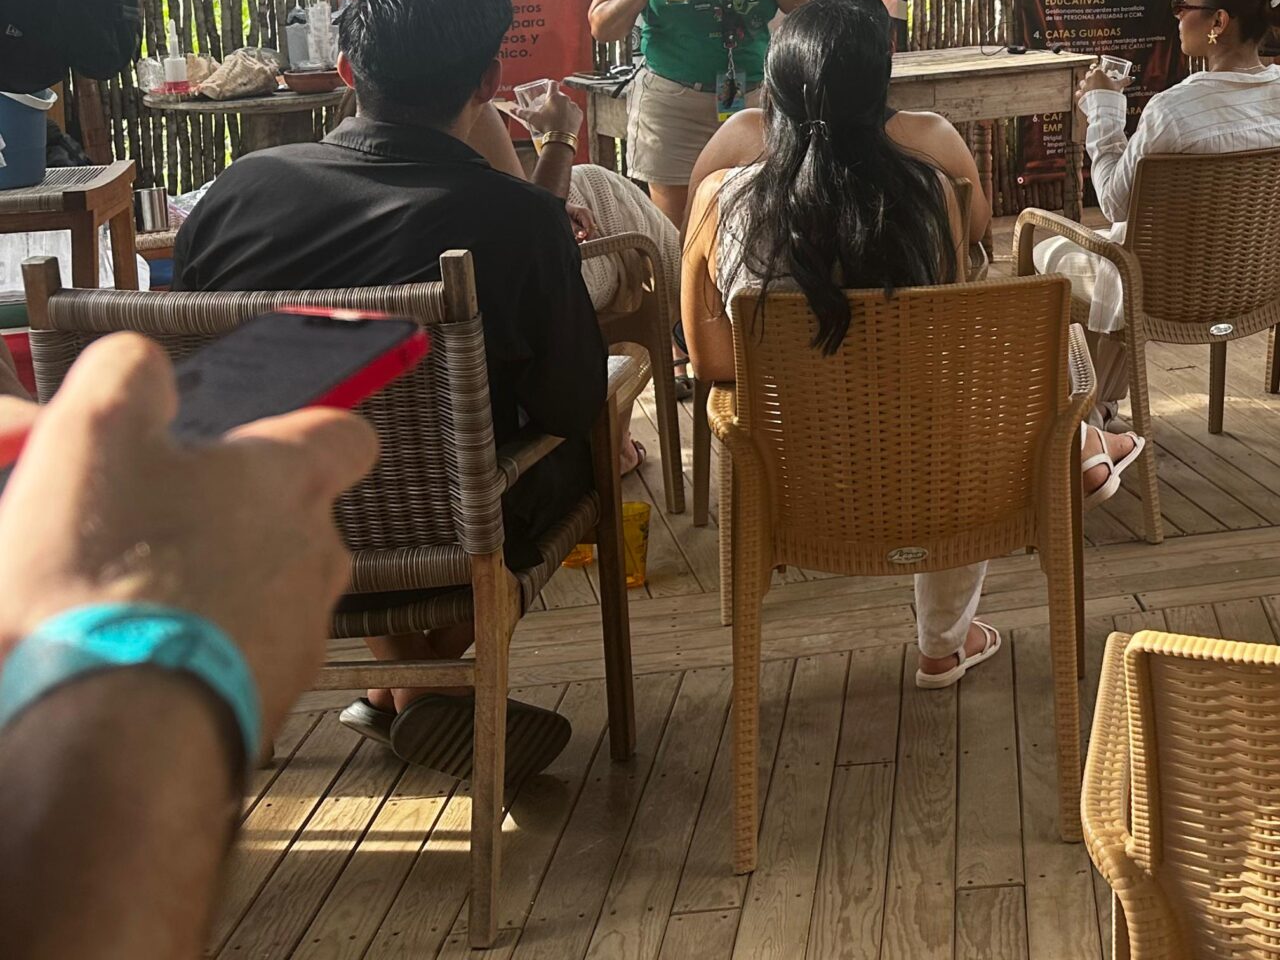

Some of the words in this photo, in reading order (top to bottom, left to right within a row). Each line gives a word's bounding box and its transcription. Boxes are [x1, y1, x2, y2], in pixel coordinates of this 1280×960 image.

[1033, 31, 1042, 39] 4.
[1046, 30, 1076, 39] CATAS
[1078, 28, 1121, 37] GUIADAS
[532, 35, 539, 45] y
